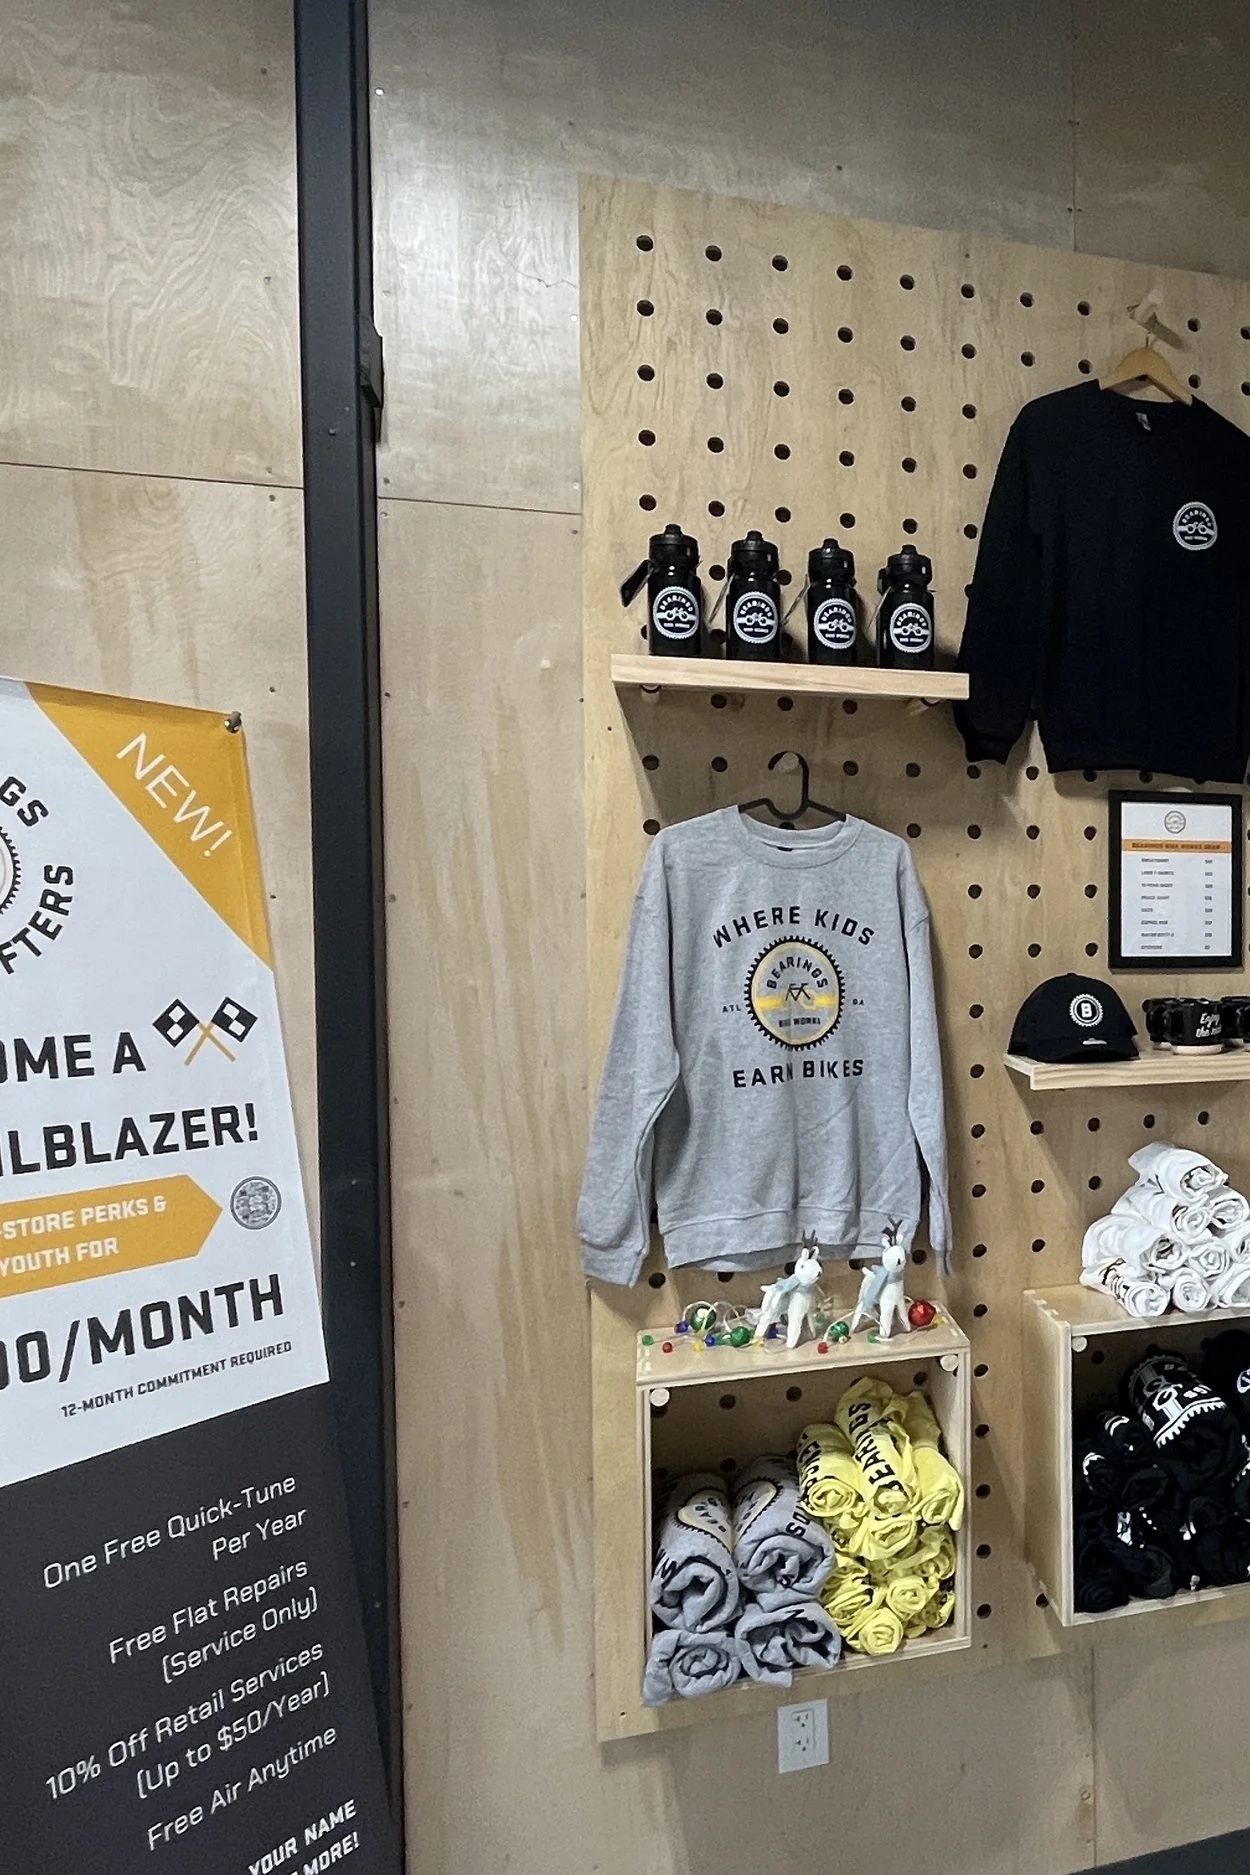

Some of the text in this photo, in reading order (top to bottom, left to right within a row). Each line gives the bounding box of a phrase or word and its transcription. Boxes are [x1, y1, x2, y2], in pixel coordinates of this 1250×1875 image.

[116, 732, 233, 857] NEW!
[713, 906, 874, 948] WHERE KIDS
[767, 957, 828, 989] BEARINGS
[113, 1032, 146, 1073] A
[803, 1060, 864, 1078] BIKES
[0, 1103, 258, 1177] LBLAZER!
[81, 1199, 148, 1226] PERKS
[0, 1237, 119, 1277] YOUTH FOR
[60, 1341, 292, 1418] 12-MONTH COMMITMENT REQUIRED
[44, 1475, 296, 1589] One Free Quick-Tune
[212, 1508, 307, 1561] Per Year
[108, 1561, 308, 1664] Free Flat Repairs
[46, 1643, 323, 1799] 10% Off Retail Services
[185, 1743, 211, 1769] to
[148, 1728, 337, 1851] Free Air Anytime
[249, 1799, 357, 1875] YOUR NAME
[303, 1832, 360, 1875] MORE!
